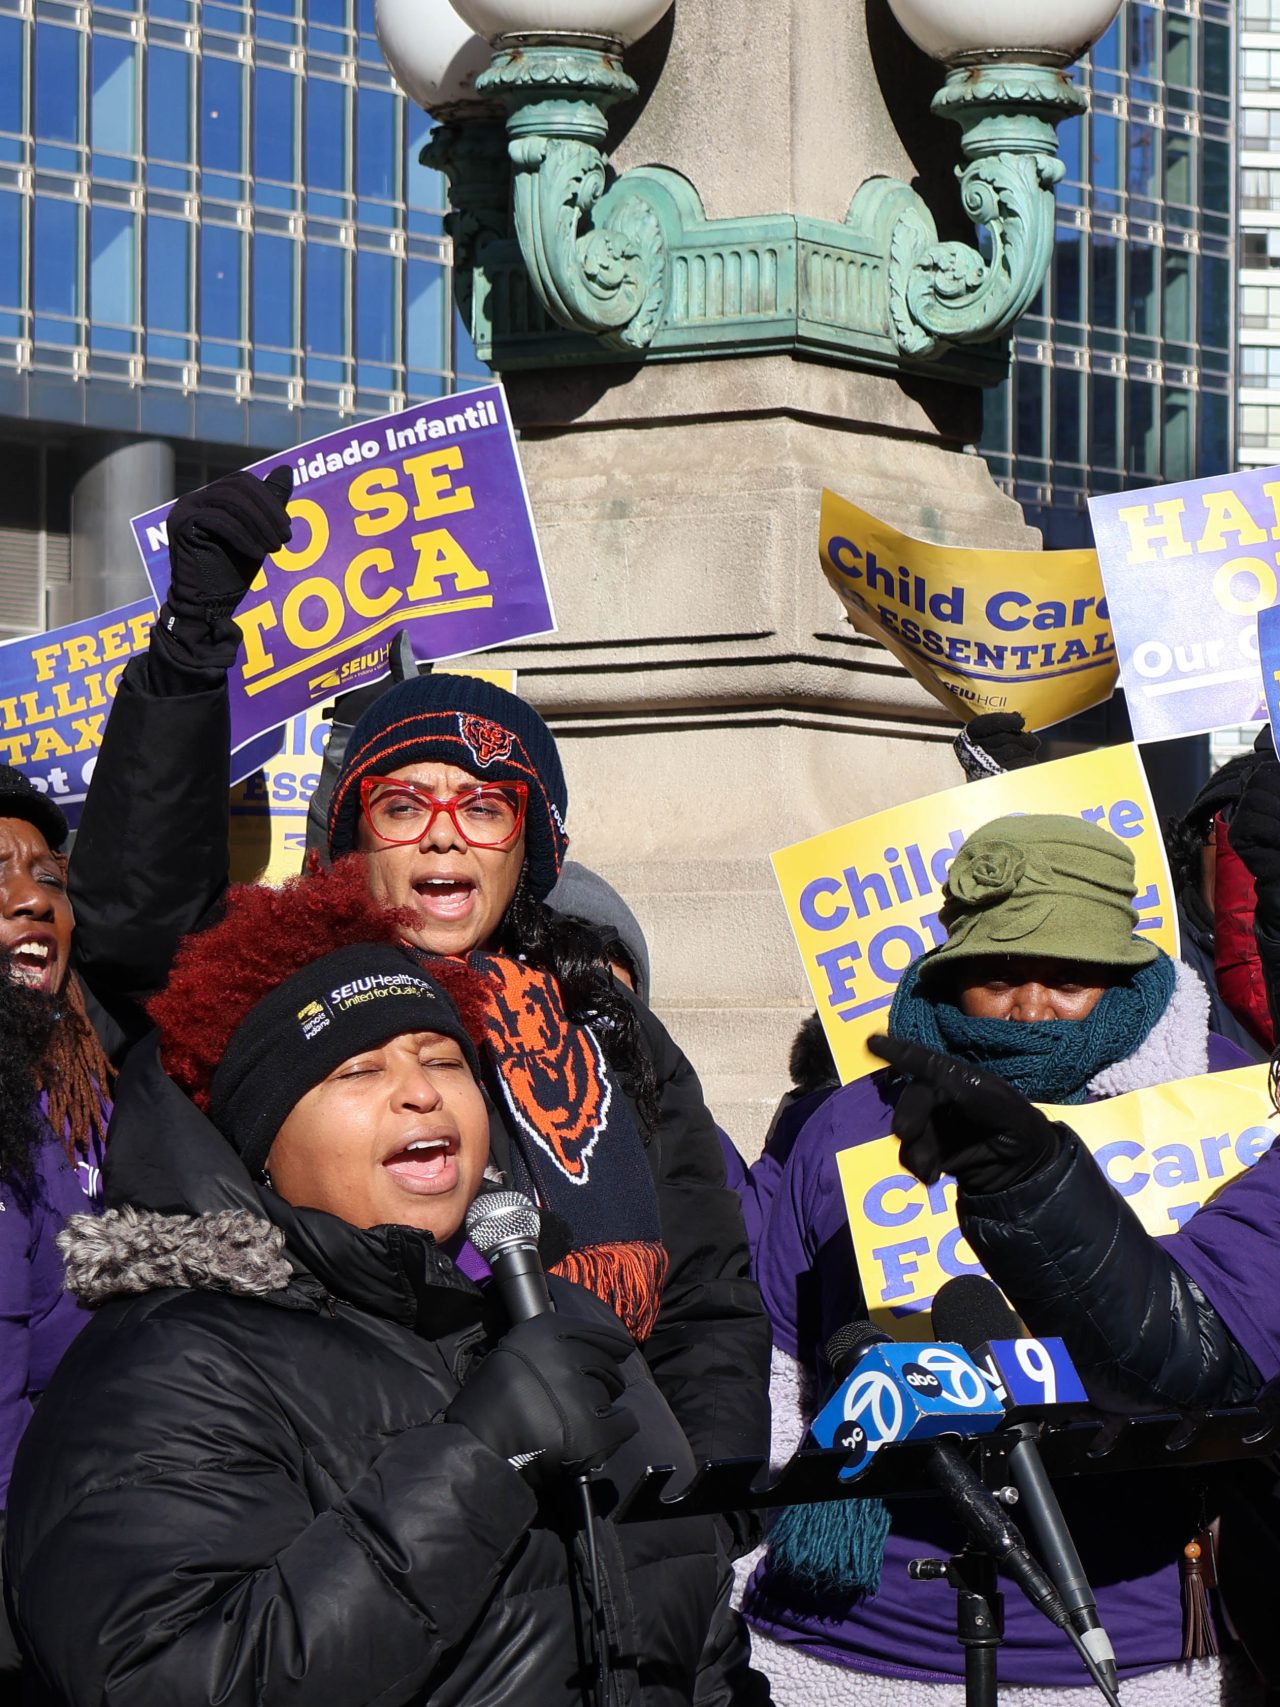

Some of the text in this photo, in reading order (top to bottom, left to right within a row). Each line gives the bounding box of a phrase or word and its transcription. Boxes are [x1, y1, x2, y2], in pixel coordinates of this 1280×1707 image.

[263, 400, 499, 487] idado Infantil
[249, 445, 476, 592] O SE
[233, 527, 490, 680] TOCA
[826, 535, 965, 625] Child
[31, 610, 161, 683] FREE
[1132, 637, 1225, 679] Our
[2, 713, 105, 767] TAX
[814, 914, 948, 1008] FO
[1092, 1125, 1279, 1197] Care
[906, 1371, 939, 1387] abc
[1014, 1338, 1057, 1404] 9
